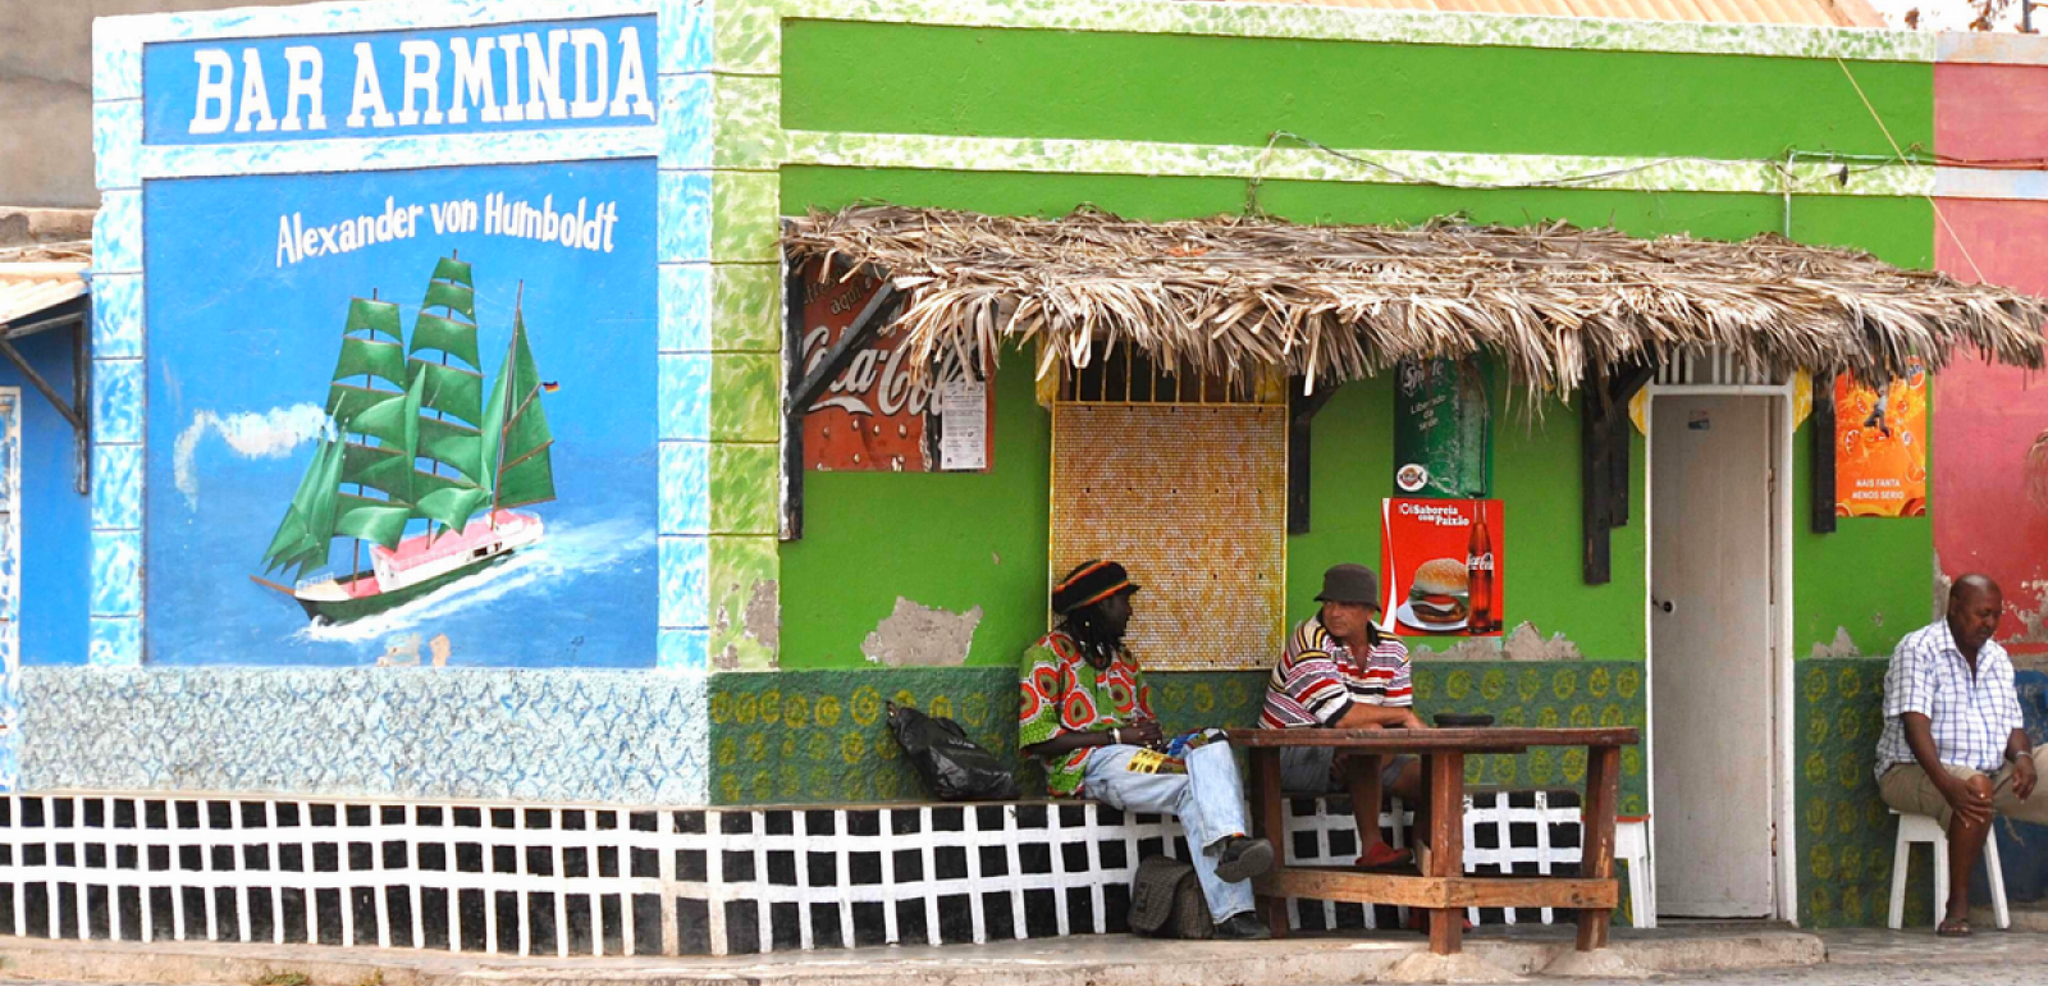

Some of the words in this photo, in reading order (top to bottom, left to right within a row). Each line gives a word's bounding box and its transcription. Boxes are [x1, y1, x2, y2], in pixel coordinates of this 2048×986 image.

[189, 46, 327, 135] BAR
[347, 26, 655, 128] ARMINDA
[276, 196, 423, 268] Alexander
[430, 198, 477, 235] von
[484, 191, 618, 253] Humboldt
[1412, 503, 1458, 514] Saboreia
[1418, 513, 1435, 521] com
[1434, 514, 1470, 526] Paixão
